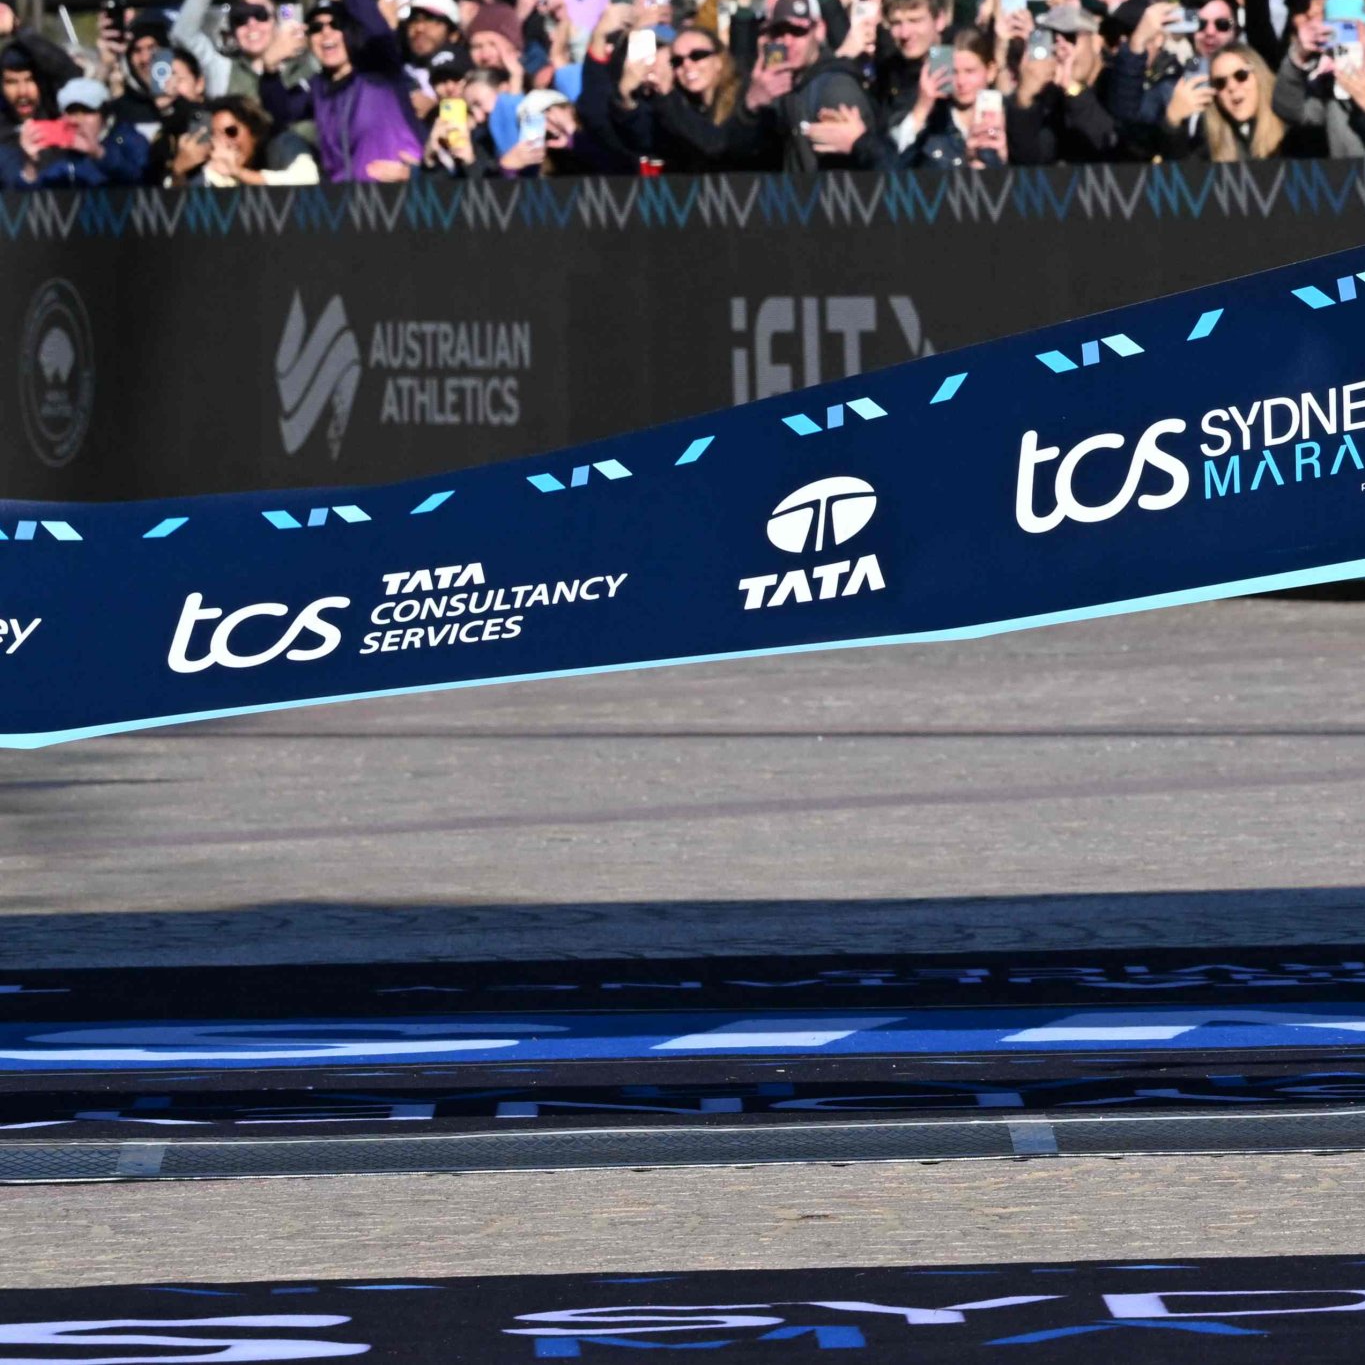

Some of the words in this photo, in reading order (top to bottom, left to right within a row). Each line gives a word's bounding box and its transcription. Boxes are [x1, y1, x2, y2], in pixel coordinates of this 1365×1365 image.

[370, 321, 530, 369] AUSTRALIAN
[380, 377, 521, 426] ATHLETICS
[369, 574, 628, 626] CONSULTANCY
[382, 563, 486, 594] TATA
[739, 554, 886, 611] TATA
[359, 615, 523, 654] SERVICES
